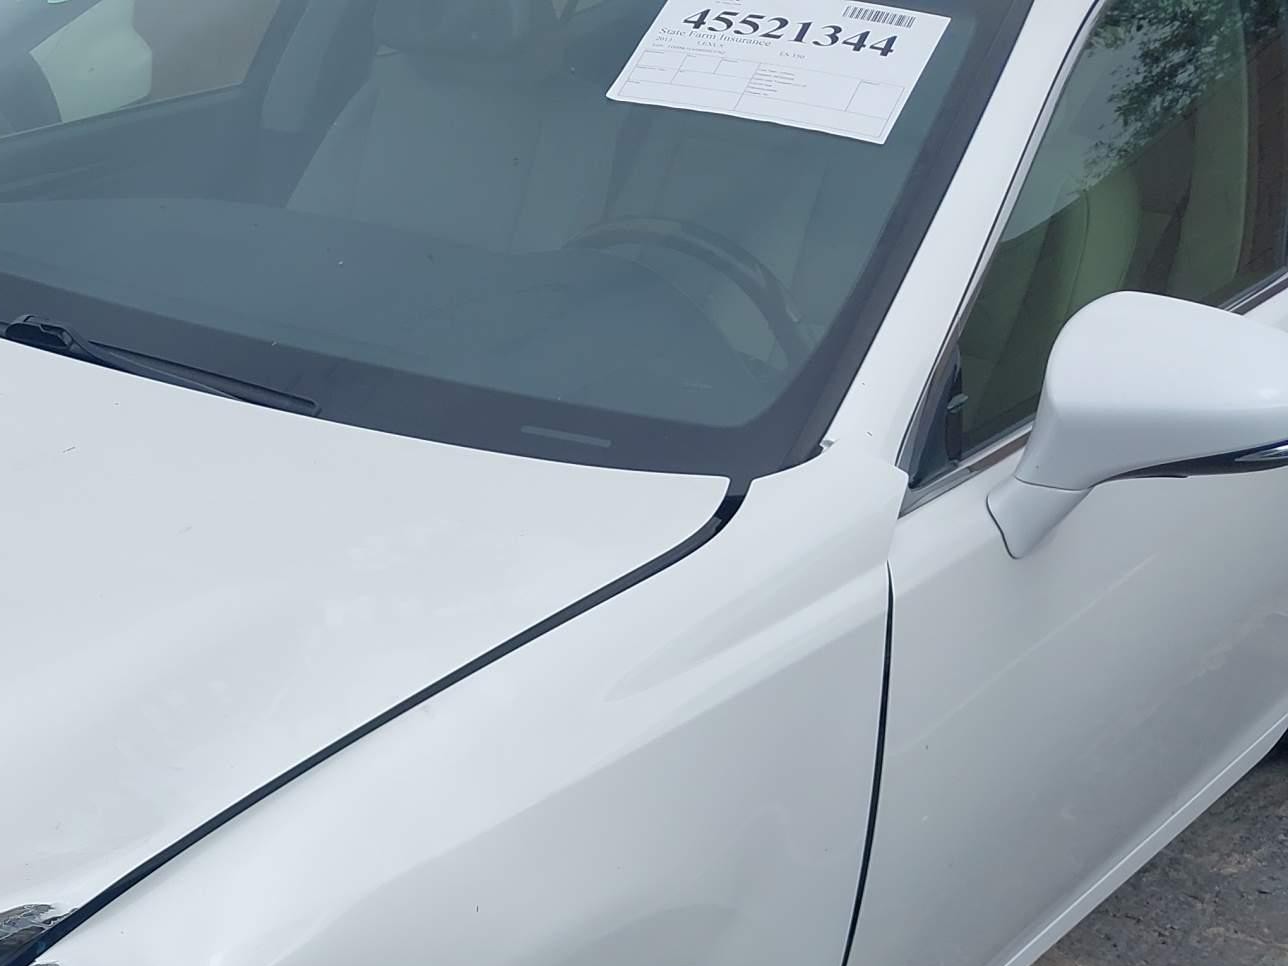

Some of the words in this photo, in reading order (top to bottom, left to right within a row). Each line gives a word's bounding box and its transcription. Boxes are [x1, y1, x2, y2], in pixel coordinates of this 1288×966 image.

[658, 27, 687, 38] State
[688, 30, 717, 41] Farm
[719, 33, 772, 47] Insurance
[682, 8, 899, 57] 45521344
